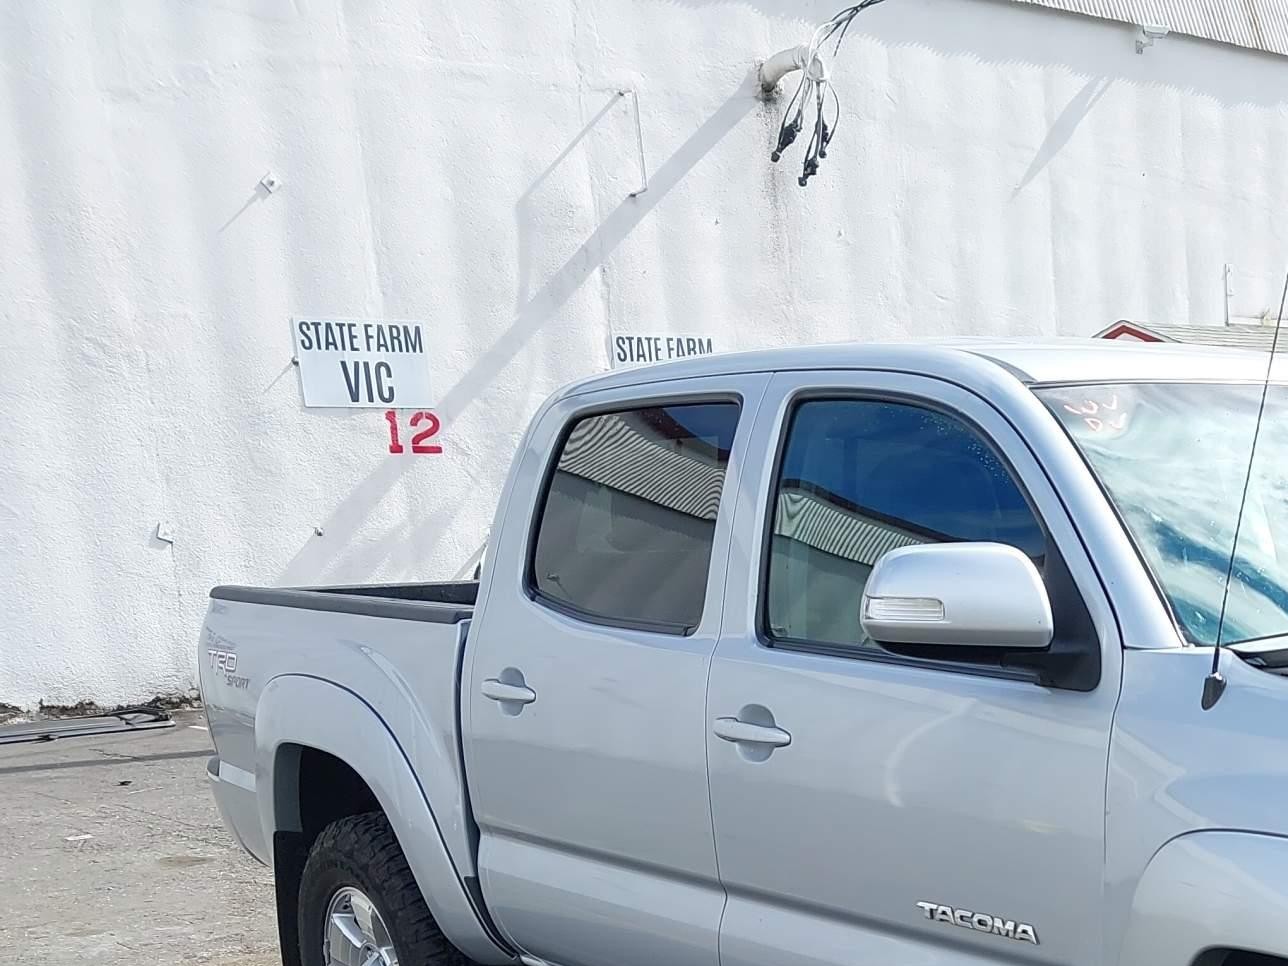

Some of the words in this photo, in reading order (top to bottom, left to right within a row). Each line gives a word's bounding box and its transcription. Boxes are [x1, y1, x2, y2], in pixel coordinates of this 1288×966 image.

[298, 321, 360, 352] STATE
[363, 324, 423, 353] FARM
[616, 336, 663, 362] STATE
[666, 337, 713, 359] FARM
[340, 360, 395, 403] VIC
[385, 410, 442, 454] 12
[208, 649, 238, 676] TRD
[916, 900, 1040, 945] TACOMA
